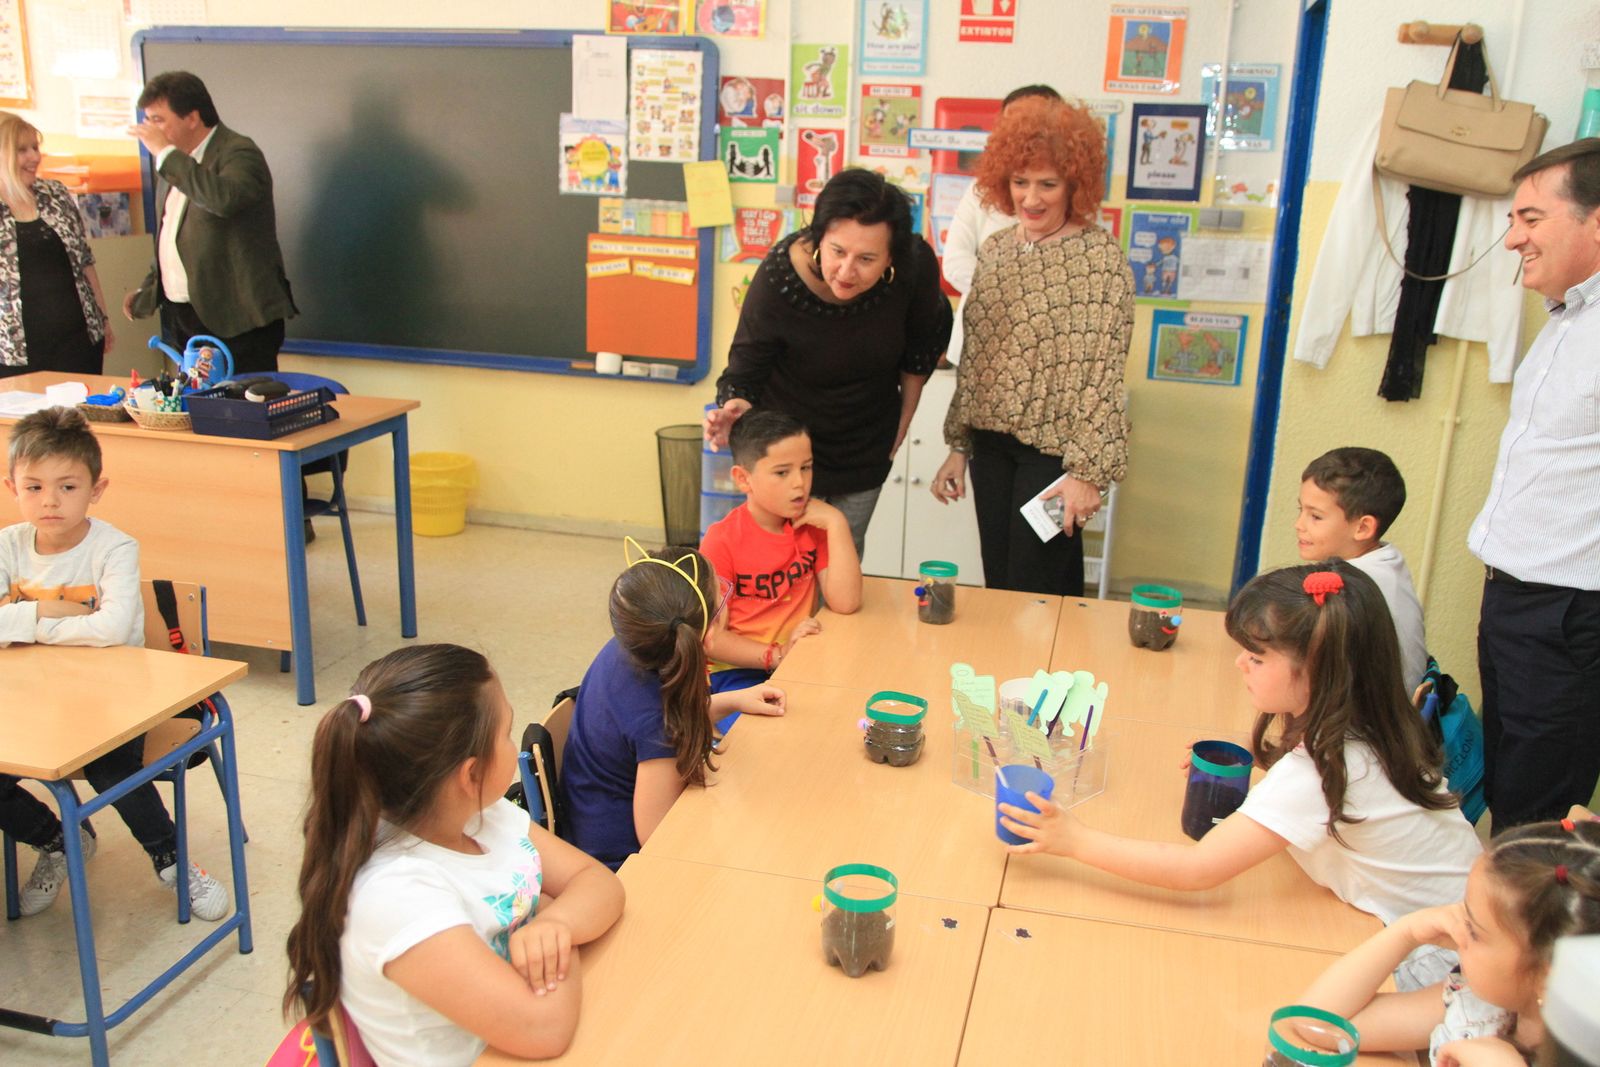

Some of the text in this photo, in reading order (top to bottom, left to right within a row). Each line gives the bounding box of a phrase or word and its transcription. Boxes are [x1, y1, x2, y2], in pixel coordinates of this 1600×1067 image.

[960, 26, 1013, 37] EXTINTOR
[795, 103, 842, 114] sit down
[1147, 170, 1177, 179] please
[735, 549, 817, 600] ESPA
